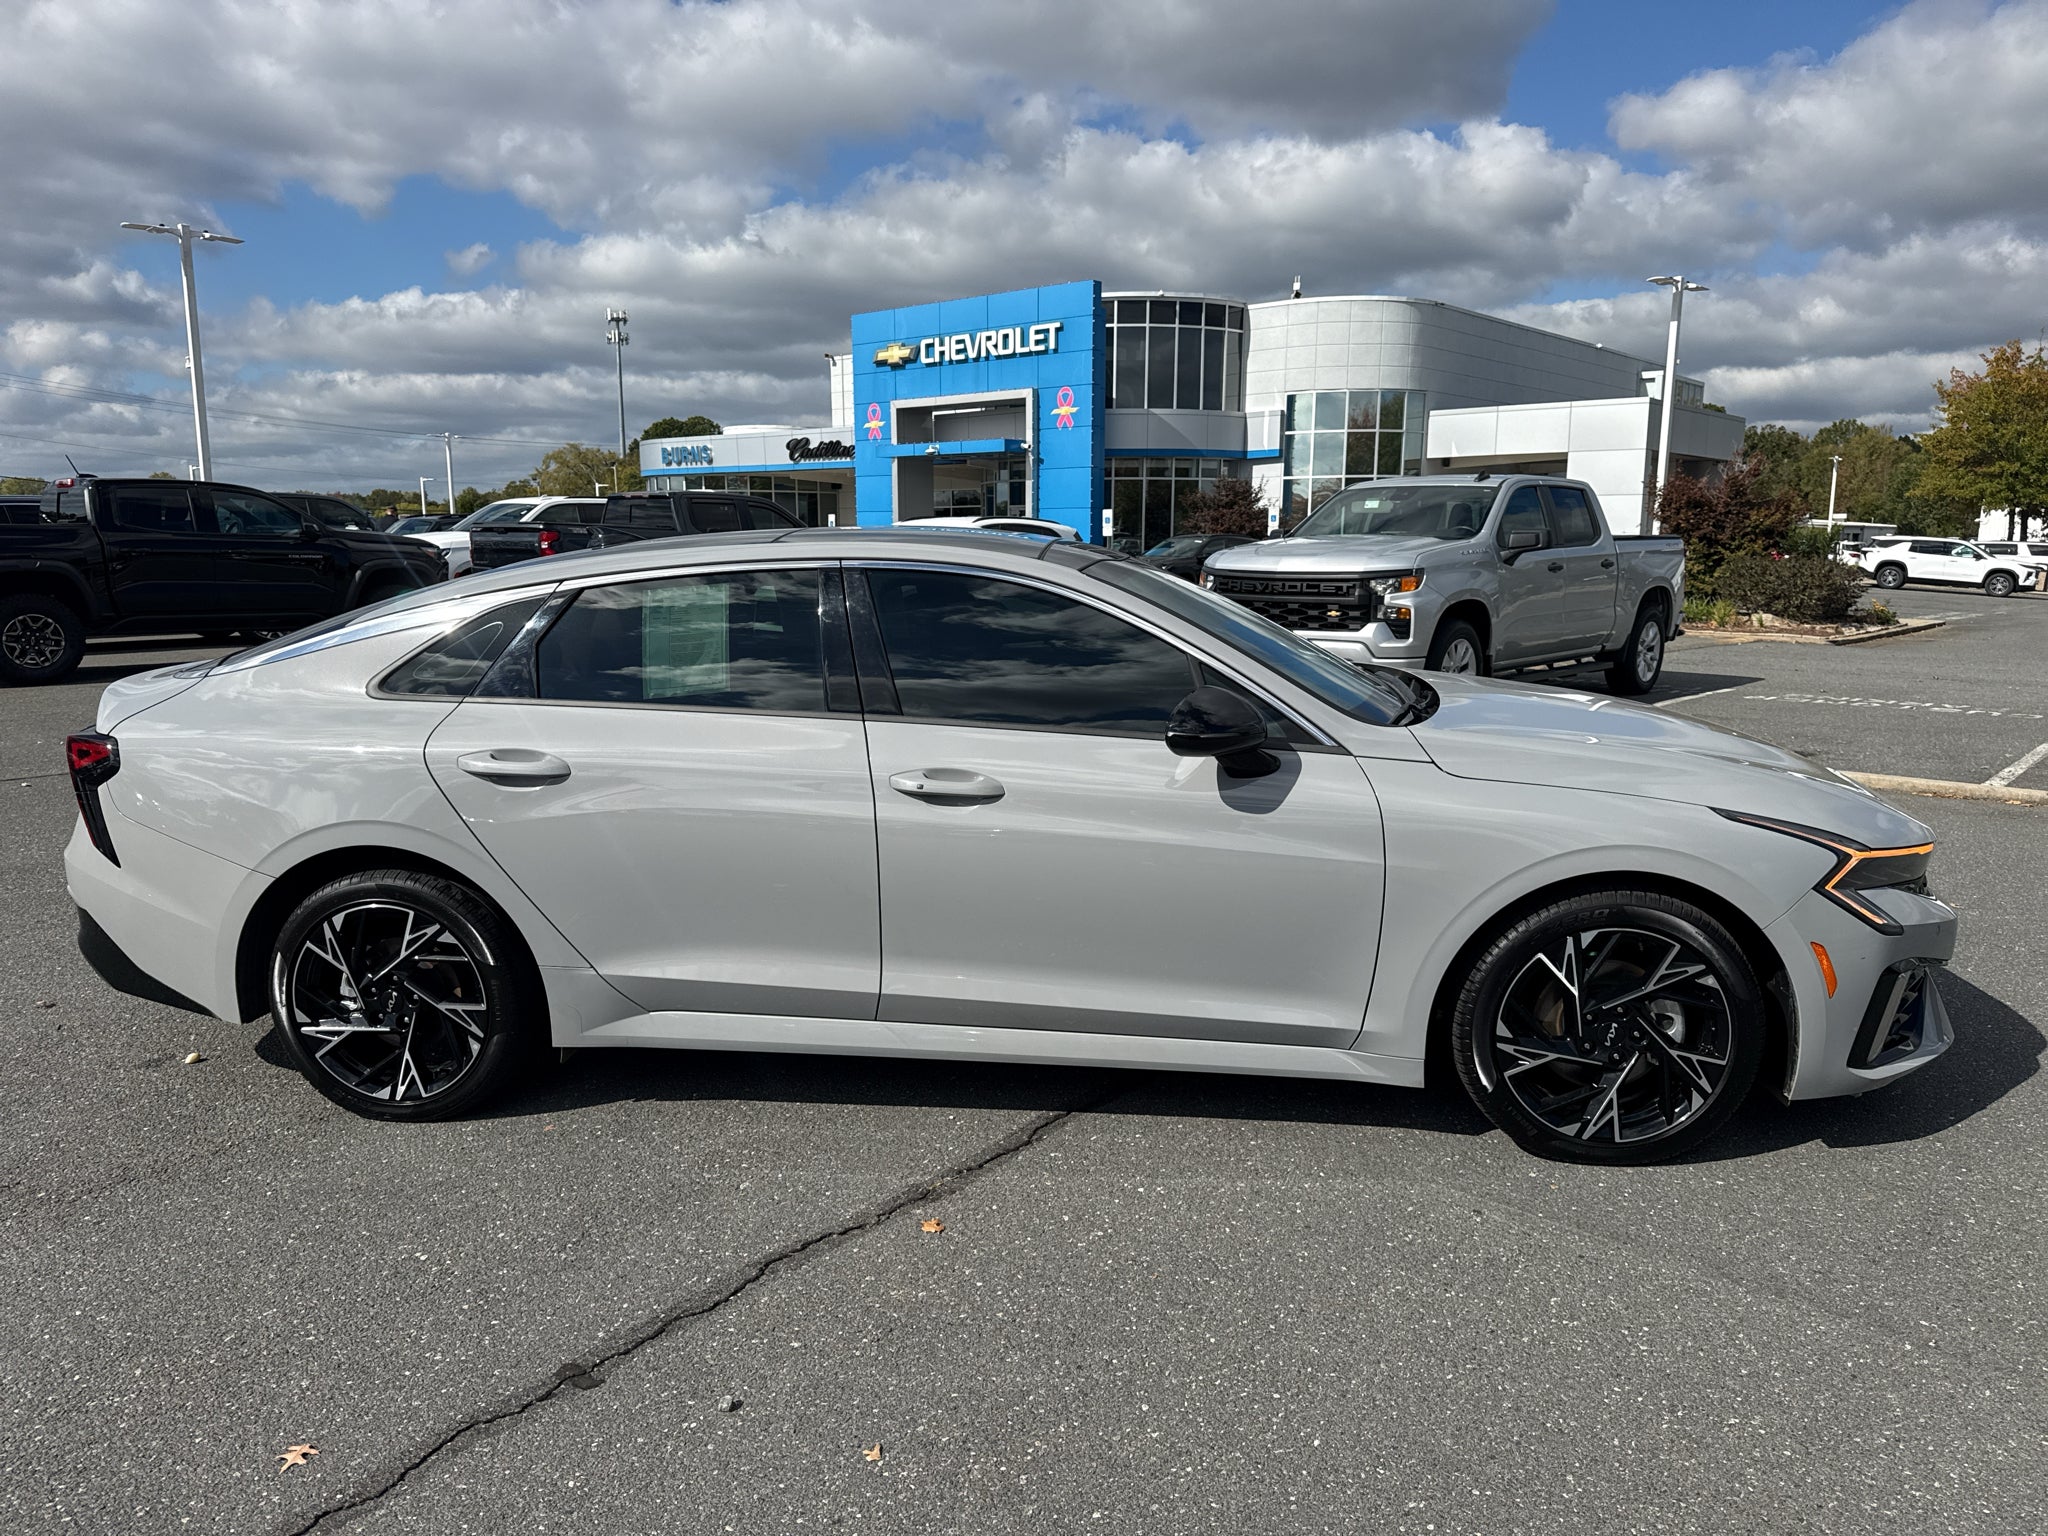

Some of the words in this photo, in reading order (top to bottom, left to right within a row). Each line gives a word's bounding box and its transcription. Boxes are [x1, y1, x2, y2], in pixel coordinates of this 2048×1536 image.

[920, 321, 1062, 365] CHEVROLET
[661, 444, 713, 465] BURNS
[785, 437, 855, 463] Cadillac
[1216, 579, 1354, 594] CHEVROLET
